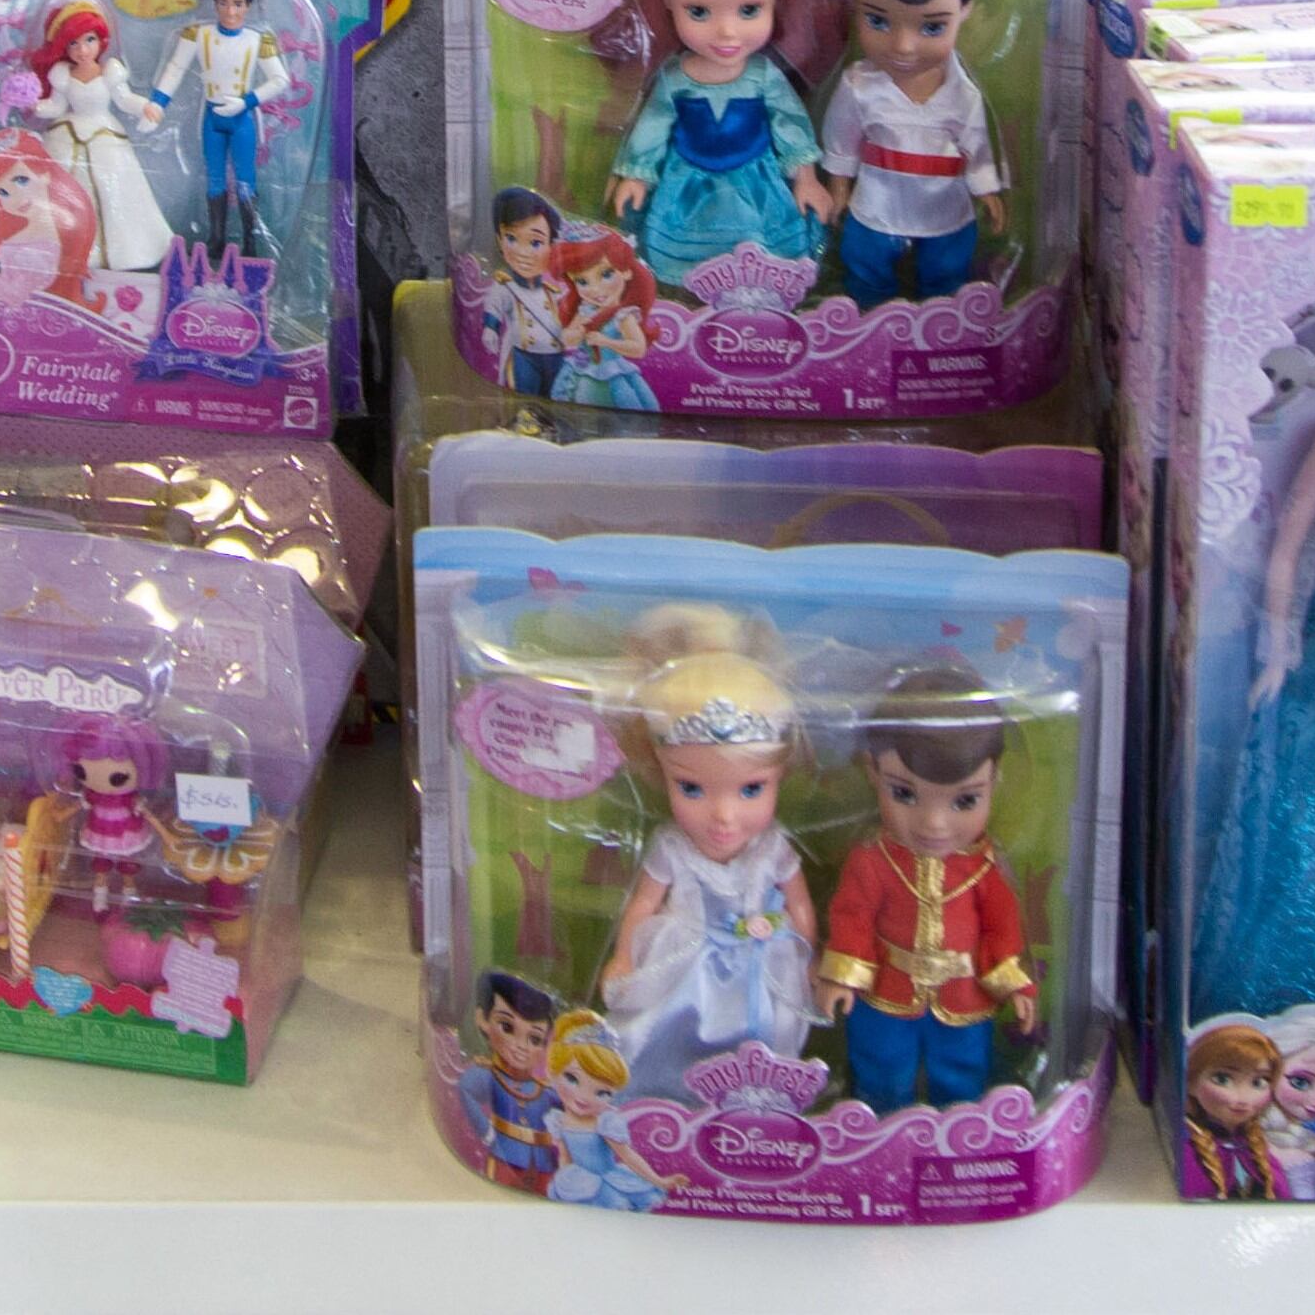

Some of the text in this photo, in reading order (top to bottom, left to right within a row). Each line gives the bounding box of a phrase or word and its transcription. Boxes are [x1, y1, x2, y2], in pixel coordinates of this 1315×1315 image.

[693, 251, 806, 298] my first
[181, 311, 254, 347] Disney
[703, 323, 803, 365] Disney
[21, 354, 122, 383] Fairytale
[18, 380, 112, 412] Wedding
[842, 388, 855, 409] 1
[56, 671, 130, 709] Party
[696, 1048, 820, 1101] my first
[706, 1122, 816, 1168] Disney
[859, 1194, 871, 1216] 1
